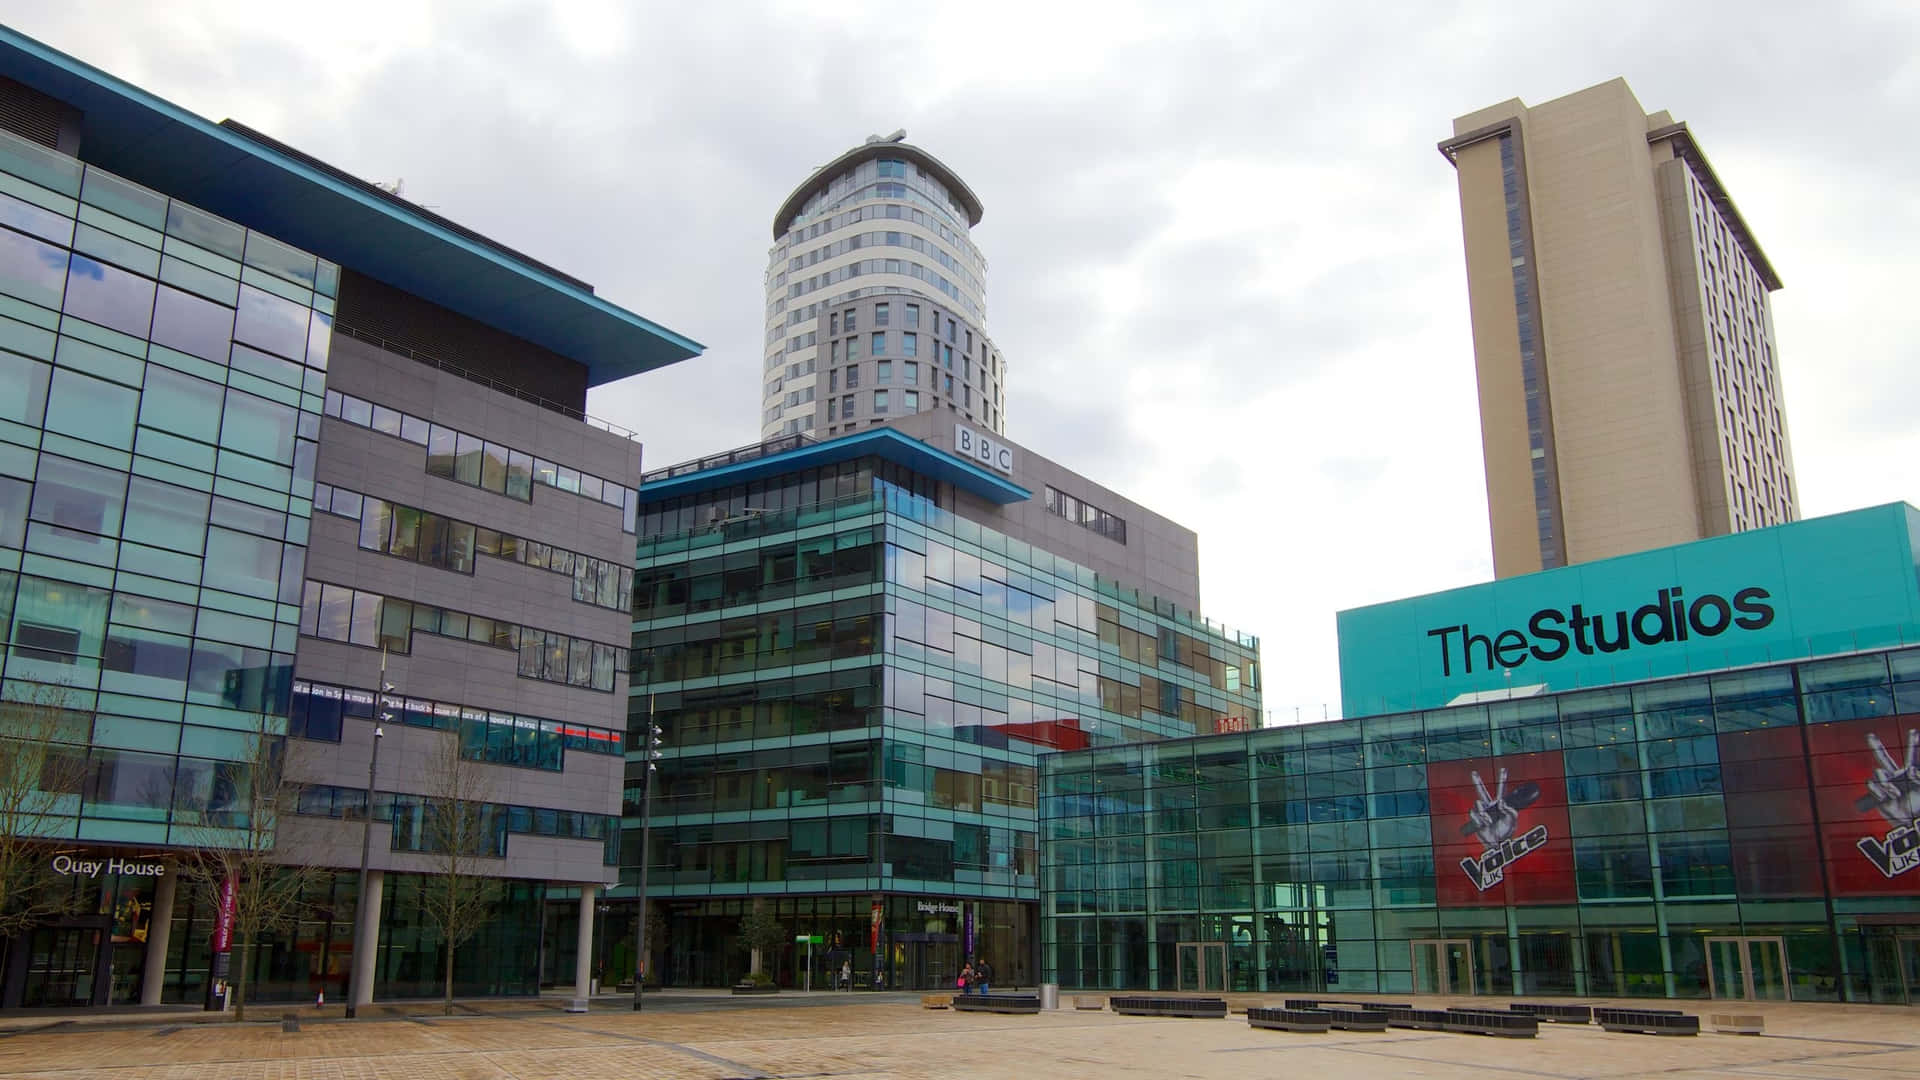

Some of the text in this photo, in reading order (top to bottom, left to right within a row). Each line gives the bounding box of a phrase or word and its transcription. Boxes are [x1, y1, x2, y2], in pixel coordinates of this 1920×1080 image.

[962, 430, 1010, 470] BBC
[425, 705, 450, 717] bcause
[53, 855, 165, 878] Quay House
[1460, 826, 1547, 890] Voice
[1893, 851, 1918, 871] UK
[1484, 869, 1502, 887] UK
